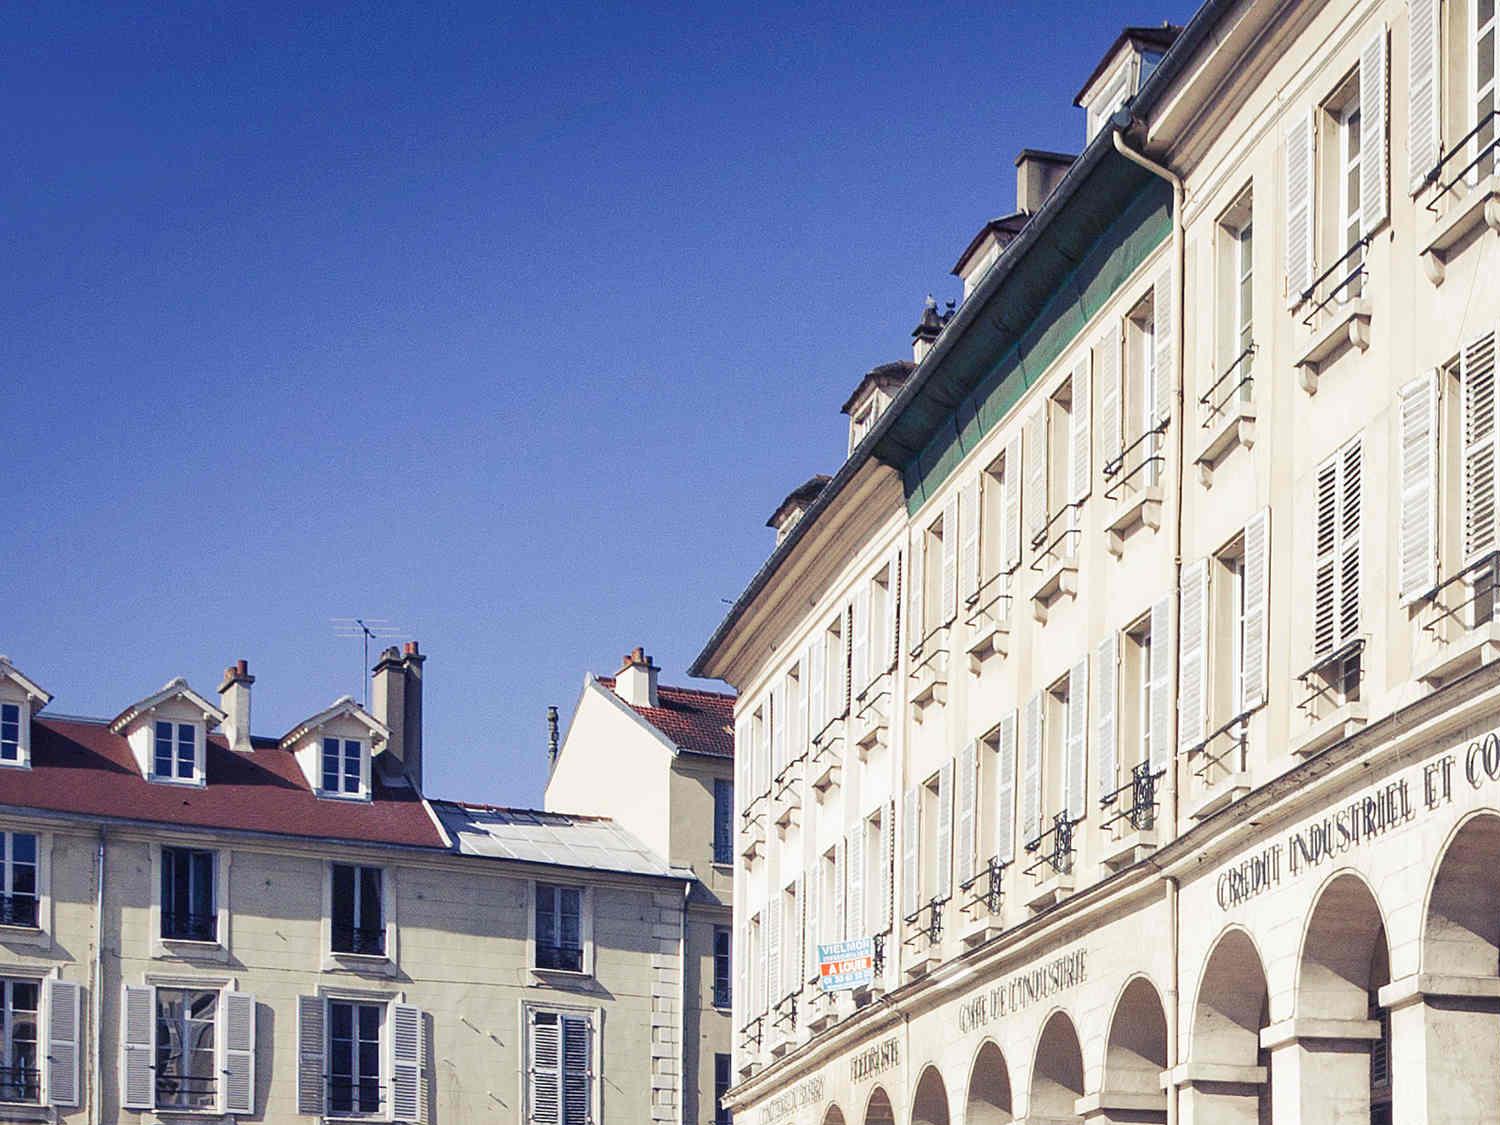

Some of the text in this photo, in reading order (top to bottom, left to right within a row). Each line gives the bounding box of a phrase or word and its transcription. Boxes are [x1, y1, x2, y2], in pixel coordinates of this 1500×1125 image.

[1216, 843, 1284, 912] CREDIT
[1288, 777, 1416, 876] INDUSTRIEL
[1423, 754, 1456, 812] ET
